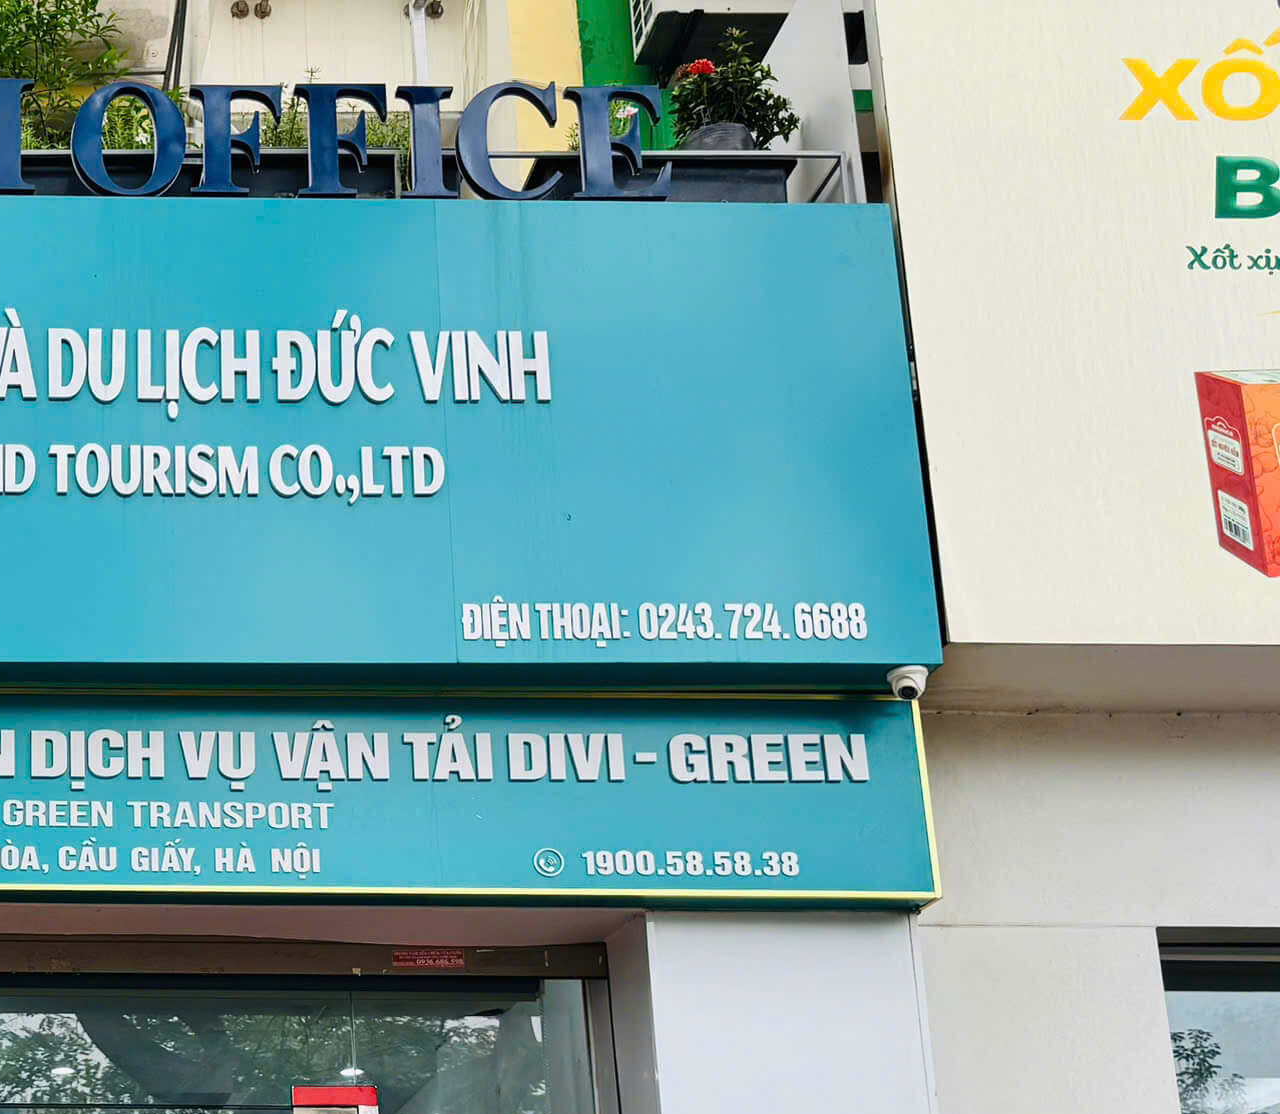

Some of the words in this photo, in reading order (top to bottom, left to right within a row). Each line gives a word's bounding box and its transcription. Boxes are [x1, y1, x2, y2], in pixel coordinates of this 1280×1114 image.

[70, 80, 672, 201] OFFICE
[1186, 243, 1242, 271] Xốt
[48, 327, 127, 403] DU
[136, 326, 262, 420] LỊCH
[272, 309, 395, 405] ĐỨC
[409, 330, 553, 403] VINH
[48, 442, 260, 497] TOURISM
[269, 444, 447, 504] CO.,LTD
[461, 595, 531, 647] ĐIỆN
[535, 601, 631, 648] THOẠI:
[30, 729, 165, 791] DỊCH
[181, 730, 257, 791] VỤ
[272, 719, 390, 792] VẬN
[403, 714, 494, 782] TẢI
[508, 732, 626, 784] DIVI
[667, 733, 870, 784] GREEN
[2, 800, 114, 829] GREEN
[127, 801, 336, 831] TRANSPORT
[58, 837, 117, 872] CẦU
[131, 838, 201, 876] GIẤY,
[215, 841, 256, 874] HÀ
[272, 842, 321, 879] NỘI
[581, 850, 800, 877] 1900.58.58.38
